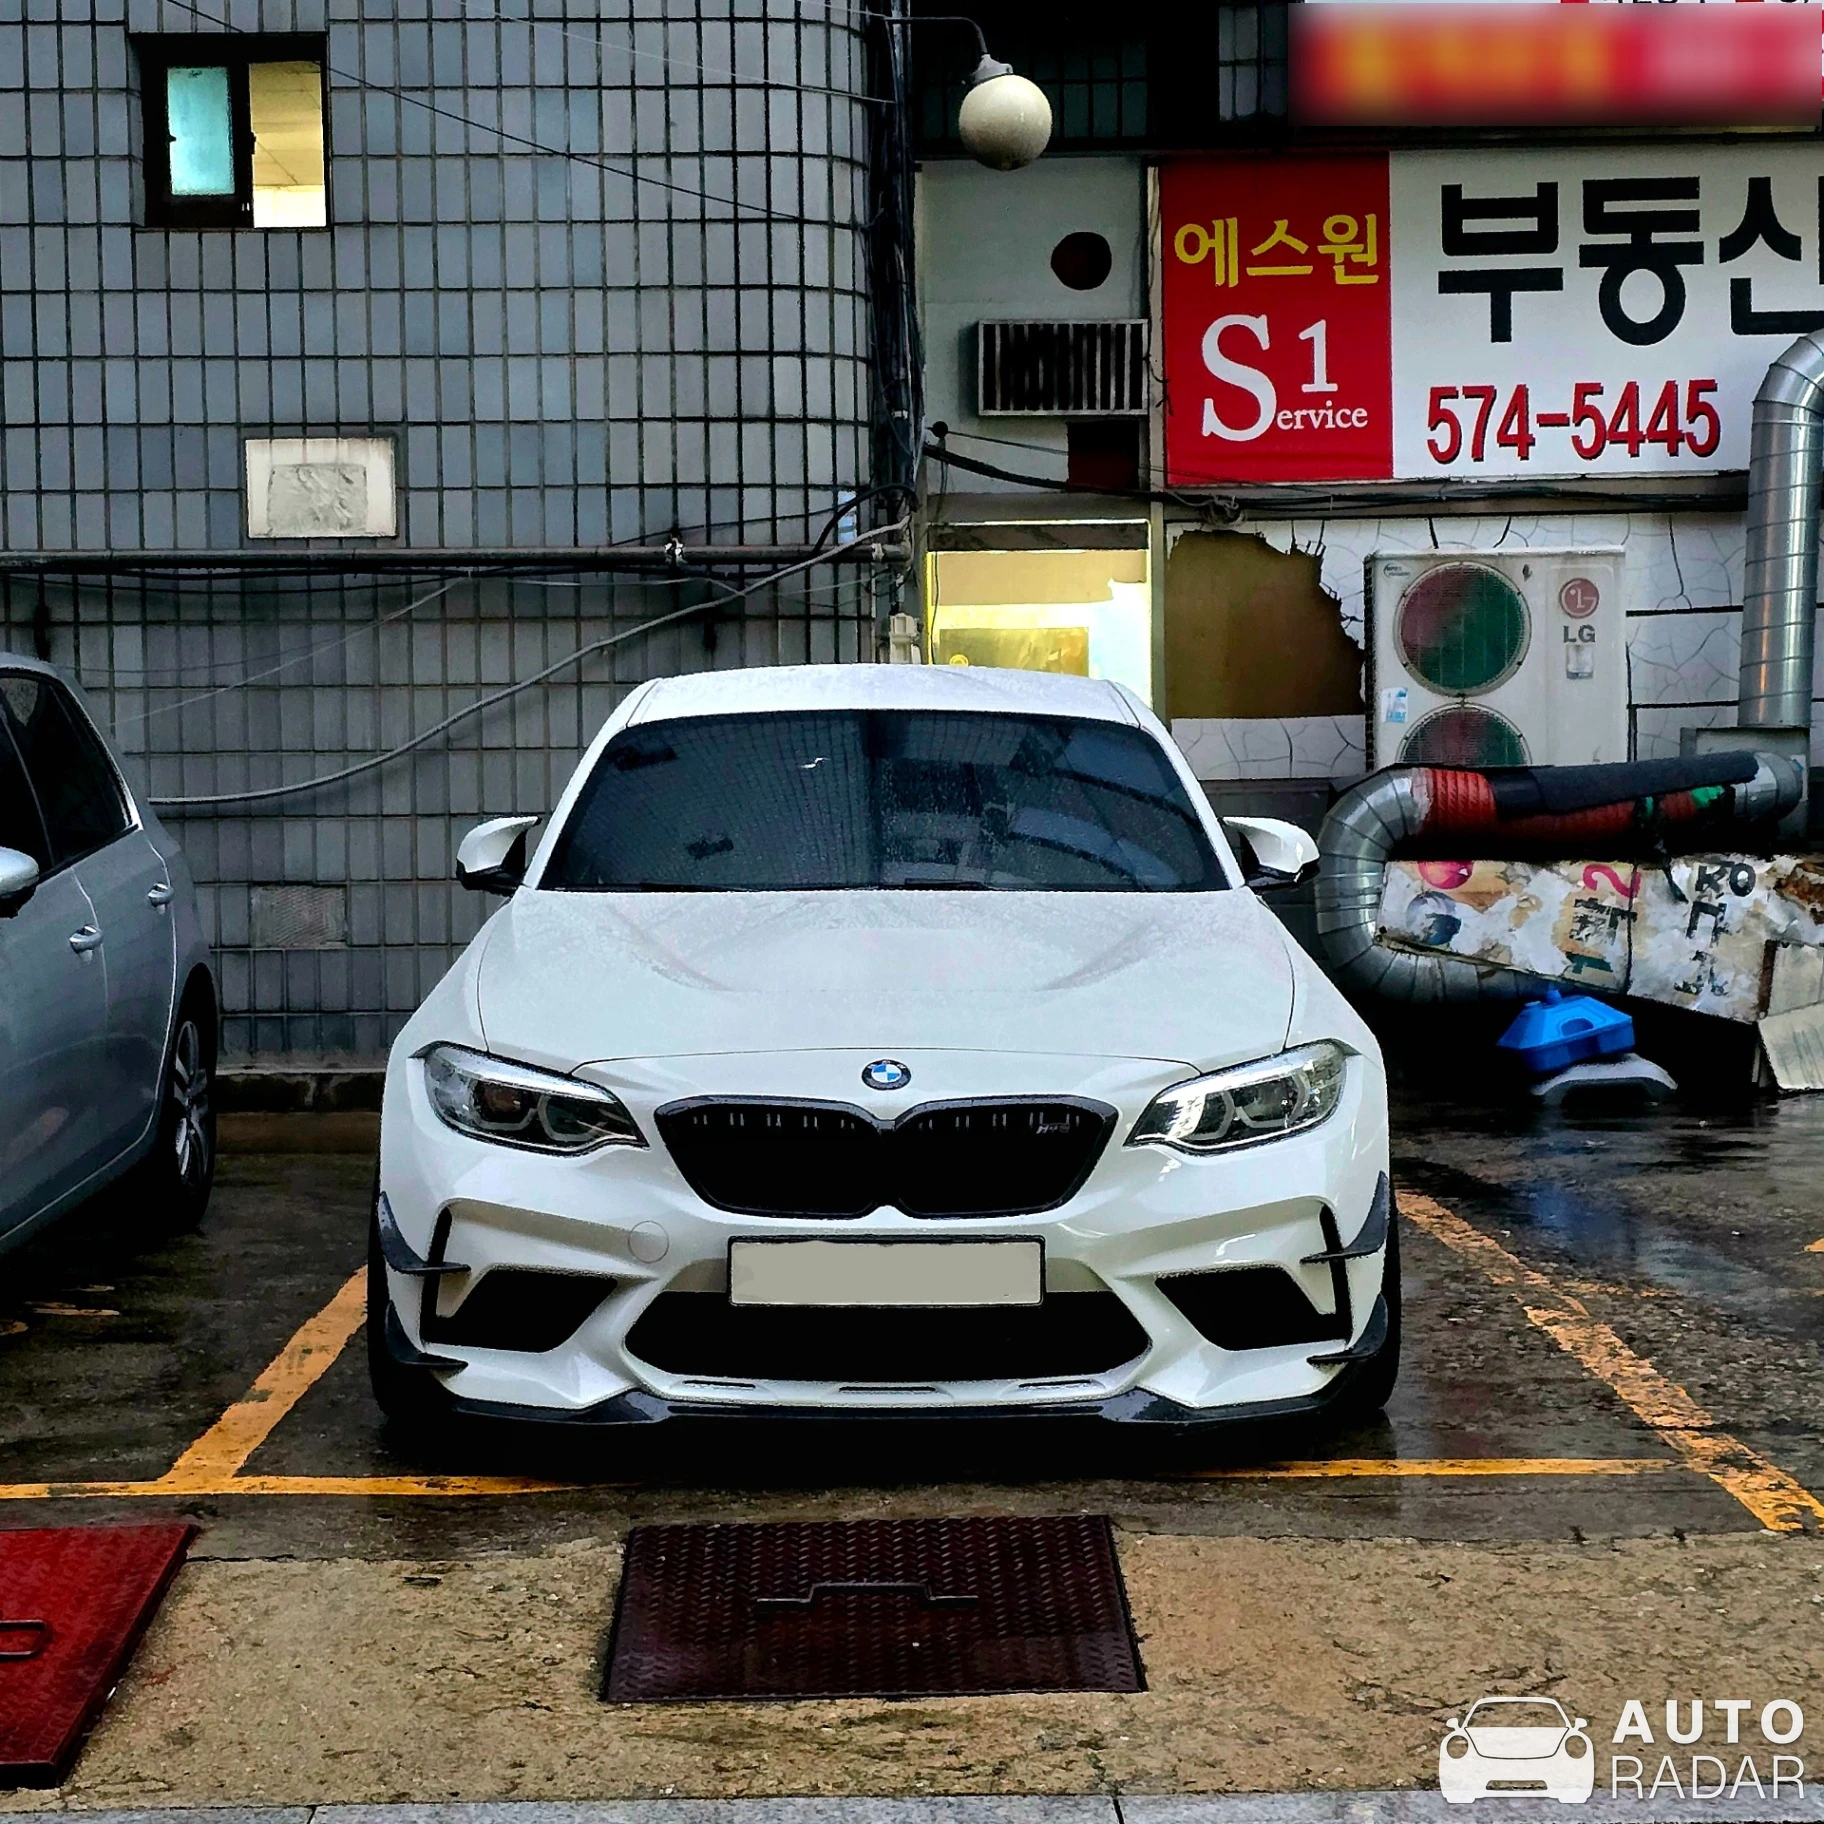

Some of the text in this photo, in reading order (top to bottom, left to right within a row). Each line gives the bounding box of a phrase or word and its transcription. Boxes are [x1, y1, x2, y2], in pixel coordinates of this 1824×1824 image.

[1174, 213, 1379, 287] 에스원
[1438, 176, 1824, 346] 부동산
[1427, 379, 1721, 465] 574-5445
[1563, 625, 1596, 643] LG
